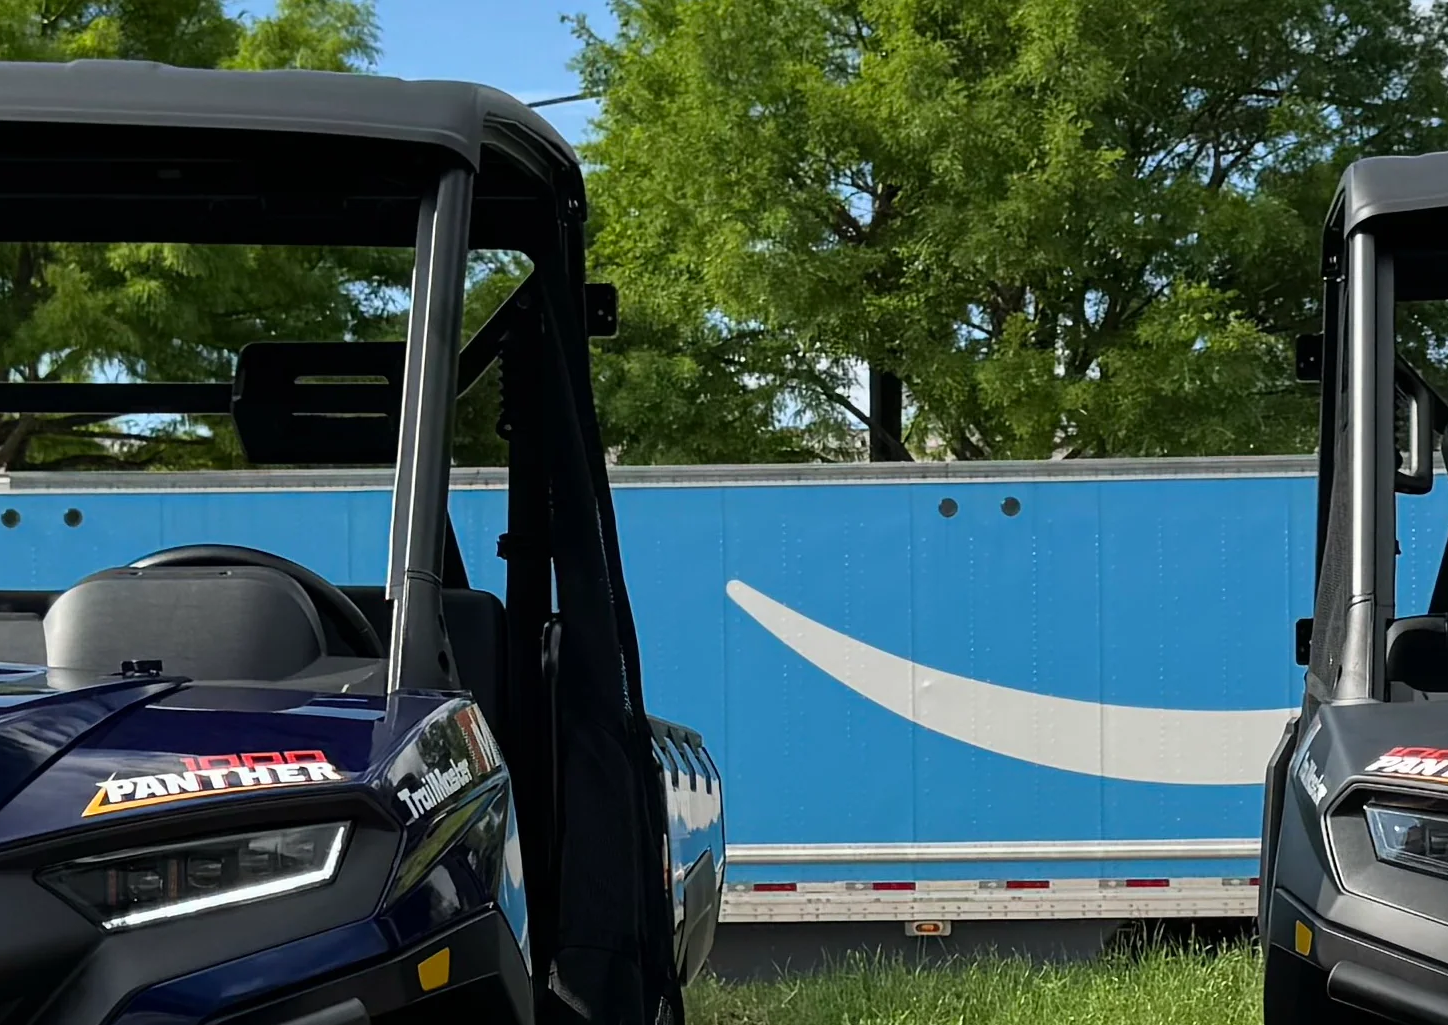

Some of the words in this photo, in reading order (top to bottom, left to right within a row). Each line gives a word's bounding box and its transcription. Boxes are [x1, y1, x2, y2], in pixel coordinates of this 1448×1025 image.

[103, 761, 342, 803] PANTHER
[179, 749, 328, 773] 1000
[397, 758, 473, 820] TrailMaster
